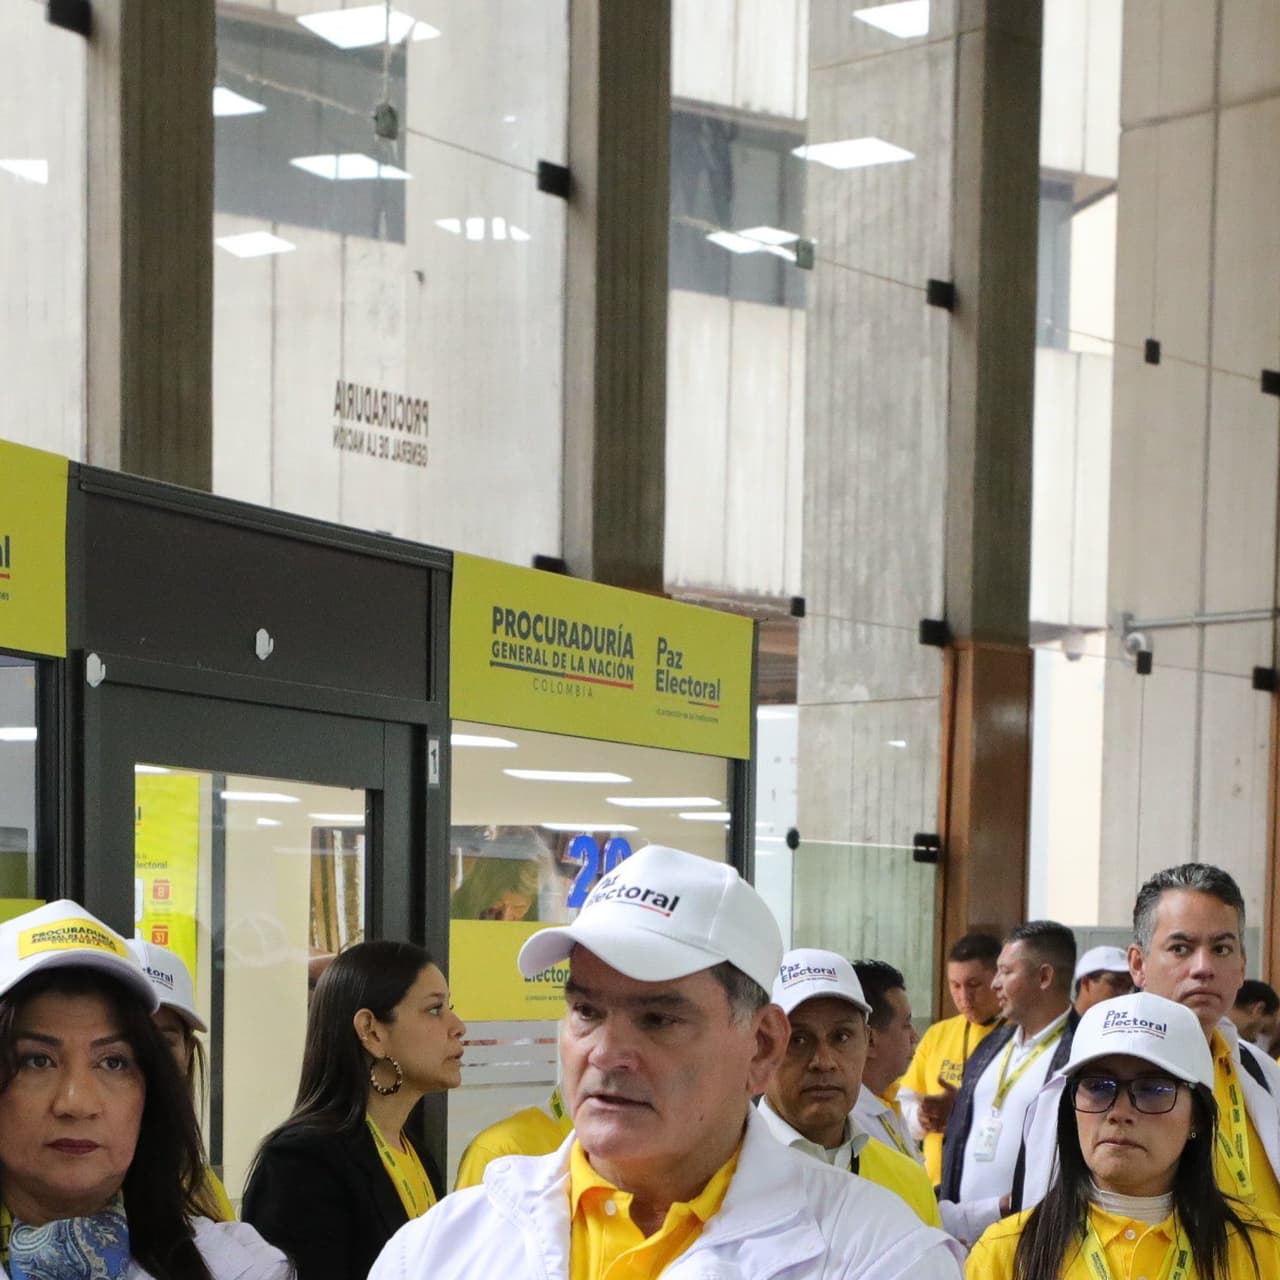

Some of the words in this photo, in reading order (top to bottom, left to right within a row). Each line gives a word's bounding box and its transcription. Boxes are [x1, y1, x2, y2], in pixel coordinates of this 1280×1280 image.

[492, 606, 634, 660] PROCURADURÍA
[491, 640, 548, 666] GENERAL
[552, 652, 567, 669] DE
[570, 655, 585, 673] LA
[589, 657, 634, 681] NACIÓN
[656, 637, 683, 669] Paz
[532, 678, 593, 697] COLOMBIA
[655, 669, 721, 701] Electoral
[135, 860, 168, 869] lectoral
[154, 933, 166, 944] 31
[141, 966, 174, 984] toral
[780, 963, 800, 976] Paz
[781, 967, 837, 983] Electoral
[1105, 1010, 1128, 1020] Paz
[1103, 1017, 1167, 1032] Electoral
